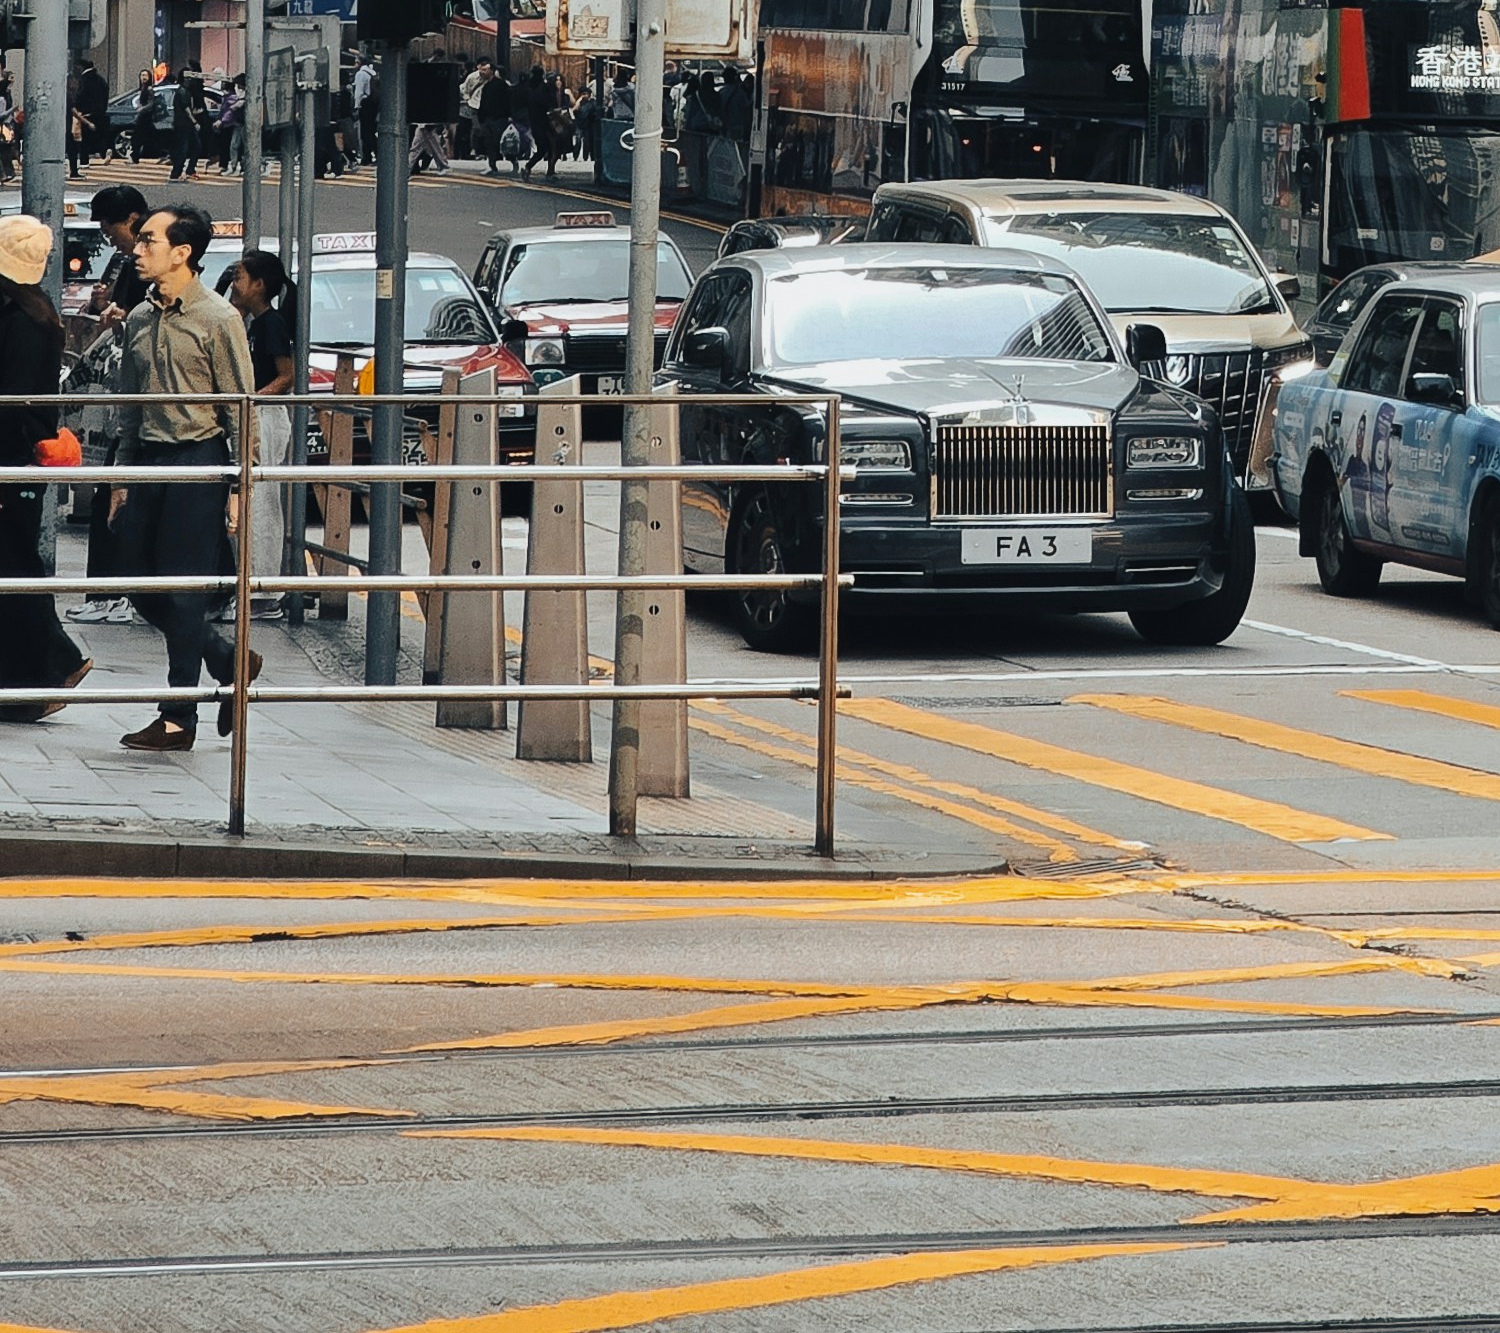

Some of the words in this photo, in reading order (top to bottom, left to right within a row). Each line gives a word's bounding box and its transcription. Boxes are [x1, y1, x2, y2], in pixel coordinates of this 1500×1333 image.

[941, 82, 966, 91] 31517
[1411, 75, 1440, 88] HONG
[1441, 75, 1471, 88] KONG
[564, 214, 610, 225] TAXI
[997, 536, 1031, 557] FA
[1042, 536, 1057, 556] 3
